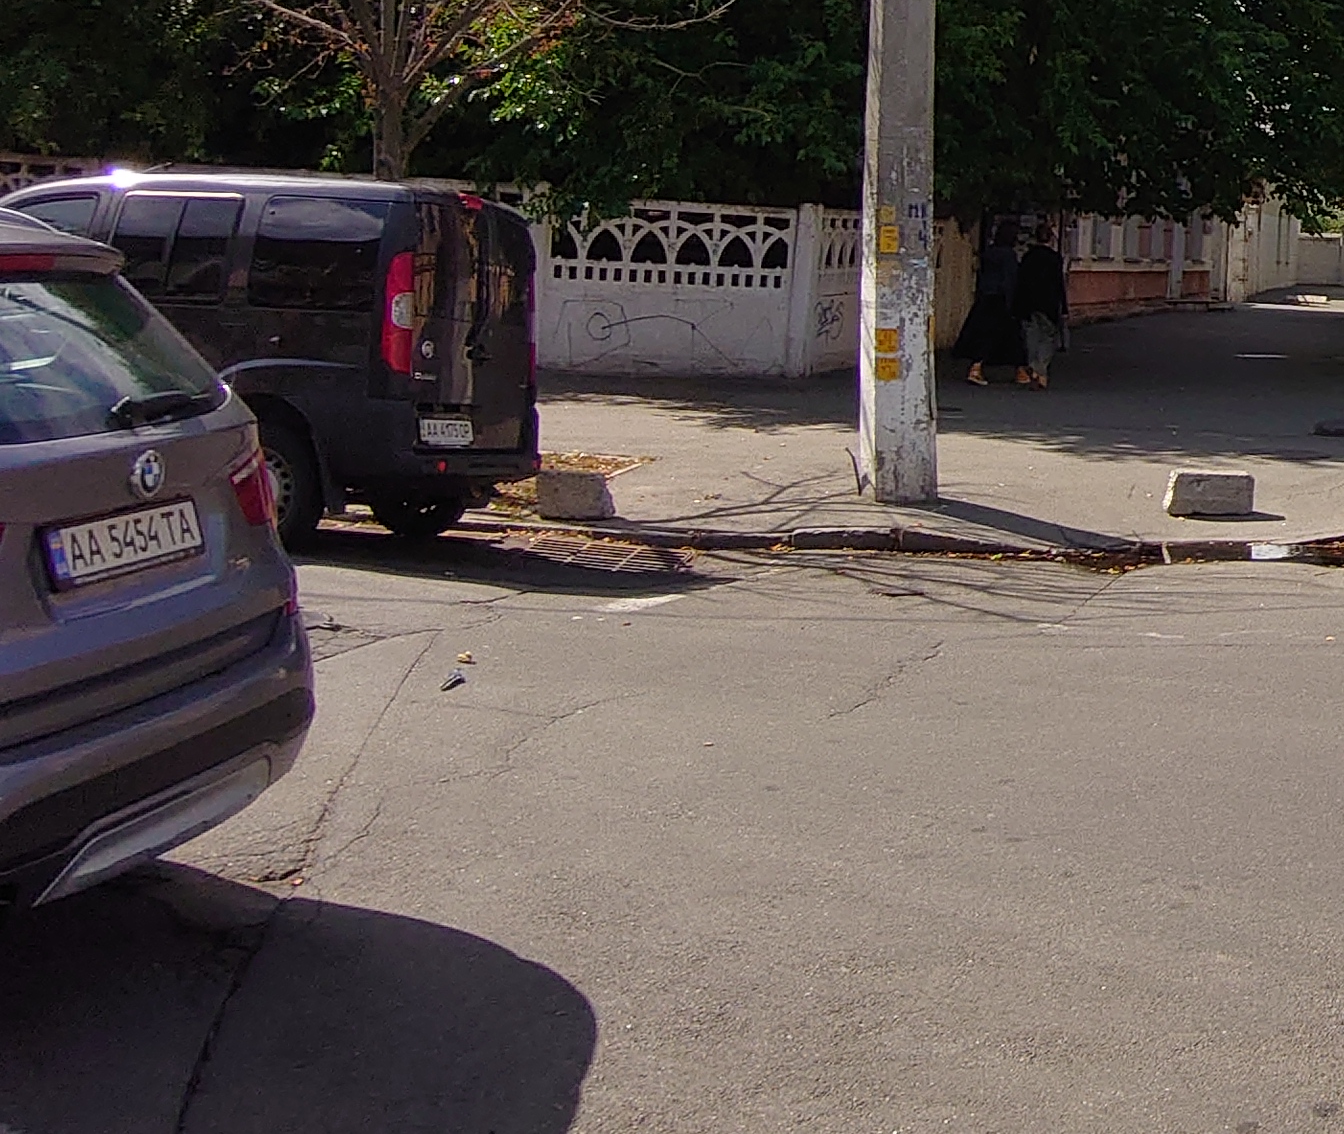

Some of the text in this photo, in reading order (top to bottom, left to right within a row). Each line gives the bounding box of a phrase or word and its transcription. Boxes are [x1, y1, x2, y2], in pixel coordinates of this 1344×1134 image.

[70, 509, 196, 570] AA 5454 TA
